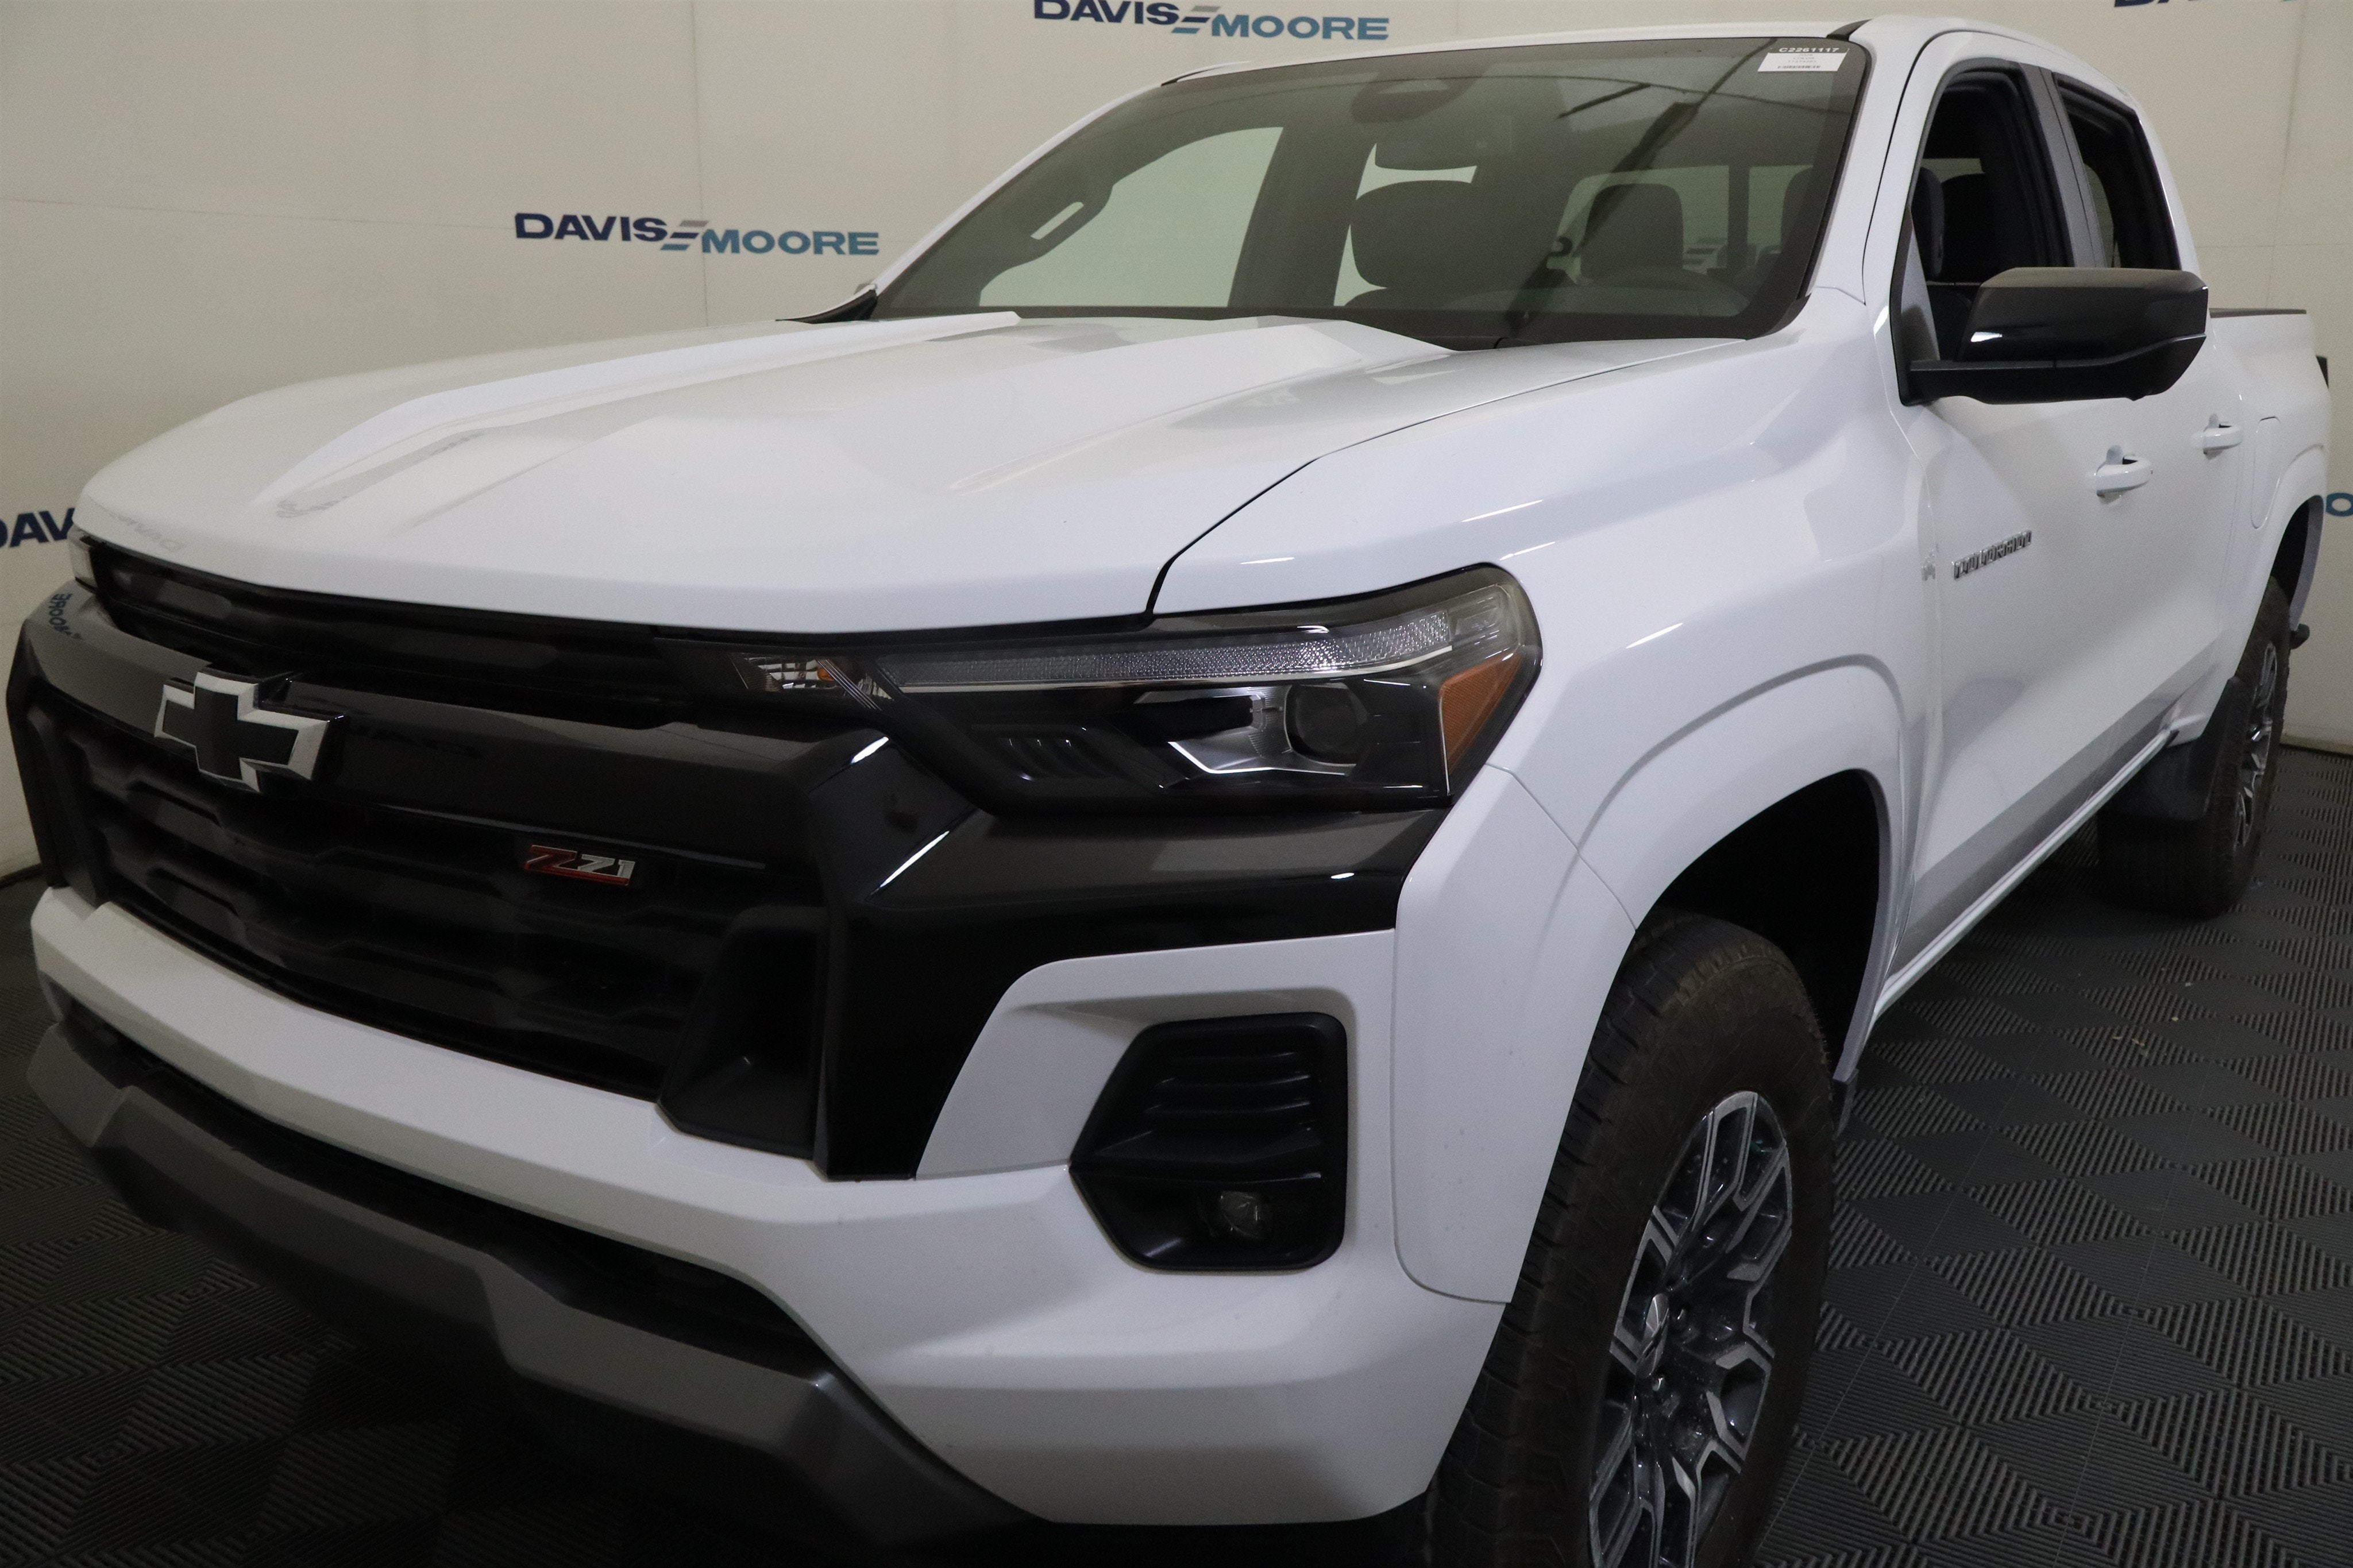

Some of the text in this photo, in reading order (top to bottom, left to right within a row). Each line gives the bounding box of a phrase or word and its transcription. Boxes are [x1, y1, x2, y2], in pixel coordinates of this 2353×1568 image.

[1034, 0, 1389, 40] DAVIS MOORE
[514, 213, 880, 255] DAVIS MOORE
[524, 844, 636, 886] Z71
